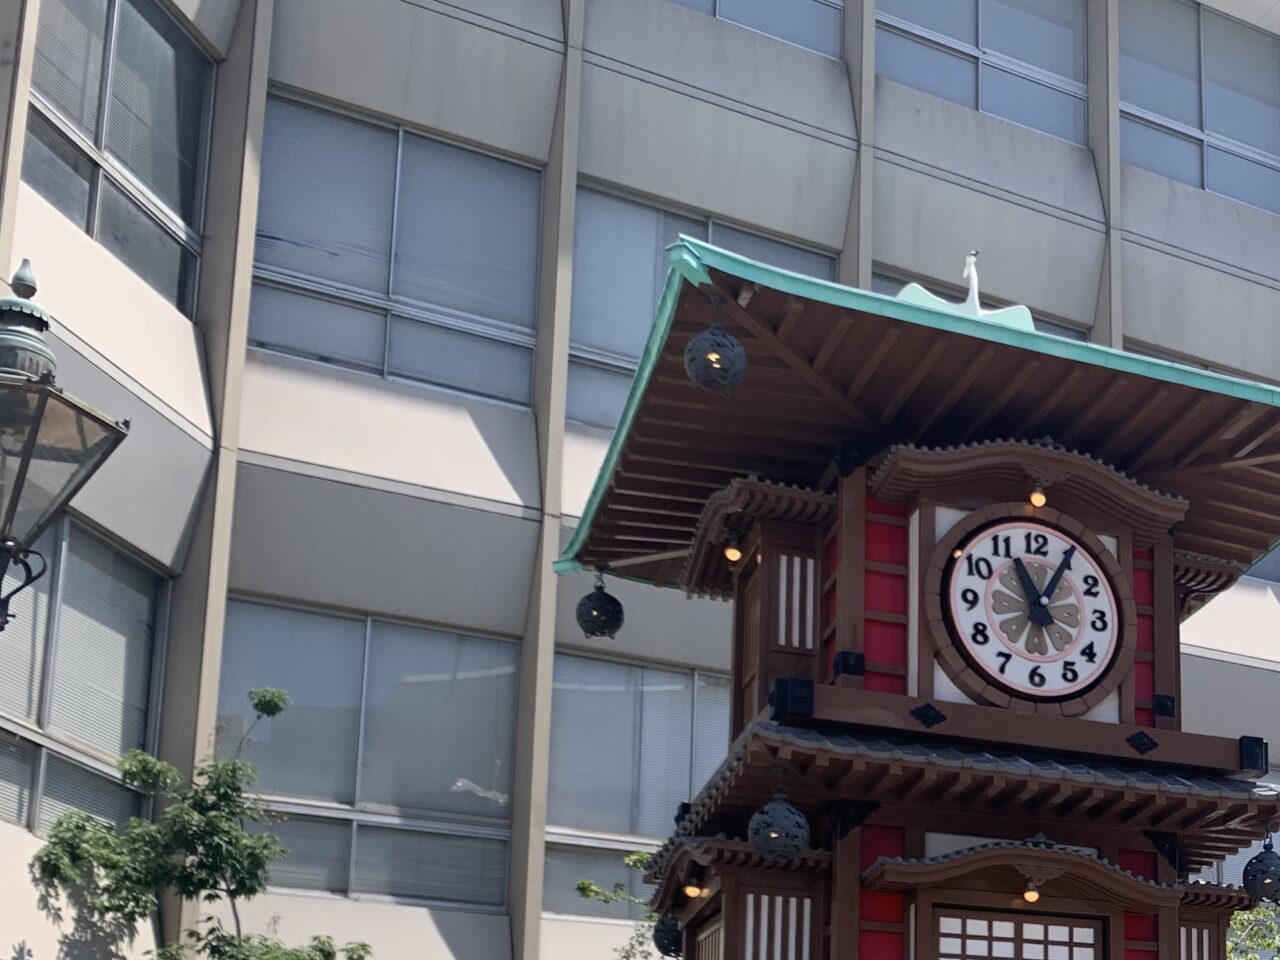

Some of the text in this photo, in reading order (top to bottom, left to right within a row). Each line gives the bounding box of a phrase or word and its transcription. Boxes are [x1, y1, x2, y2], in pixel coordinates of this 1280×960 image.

[991, 535, 1013, 559] 11
[1024, 532, 1049, 557] 12
[966, 554, 992, 580] 10
[1083, 575, 1100, 598] 2
[961, 589, 979, 612] 9
[1091, 609, 1108, 632] 3
[971, 622, 989, 645] 8
[996, 652, 1013, 675] 7
[1080, 641, 1097, 663] 4
[1028, 665, 1046, 688] 6
[1061, 661, 1078, 683] 5
